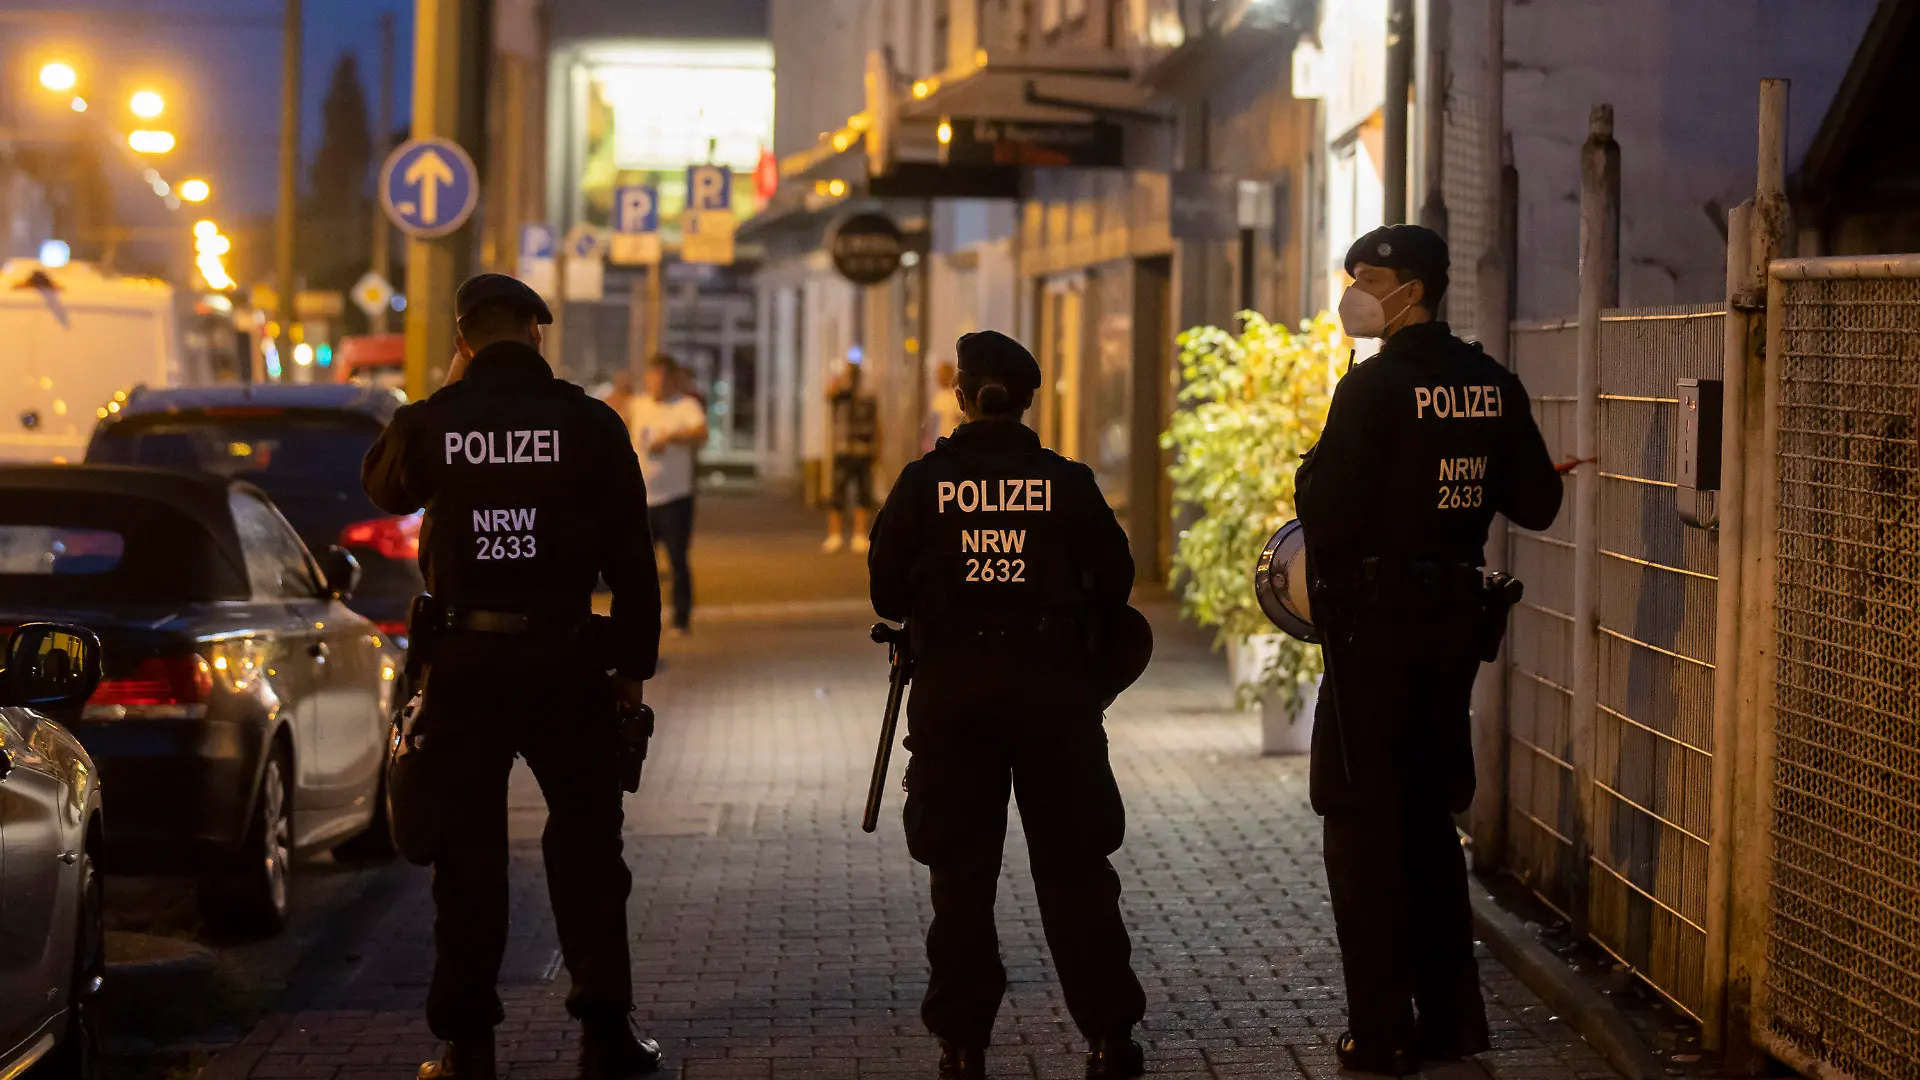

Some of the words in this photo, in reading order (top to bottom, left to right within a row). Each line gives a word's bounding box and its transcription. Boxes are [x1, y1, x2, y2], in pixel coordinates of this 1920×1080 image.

[693, 166, 723, 208] P
[621, 188, 651, 232] P
[1415, 386, 1502, 418] POLIZEI
[445, 430, 560, 464] POLIZEI
[1439, 457, 1487, 481] NRW
[938, 479, 1052, 513] POLIZEI
[1438, 485, 1483, 509] 2633
[473, 508, 537, 532] NRW
[476, 535, 537, 560] 2633
[961, 529, 1026, 553] NRW
[965, 558, 1026, 582] 2632
